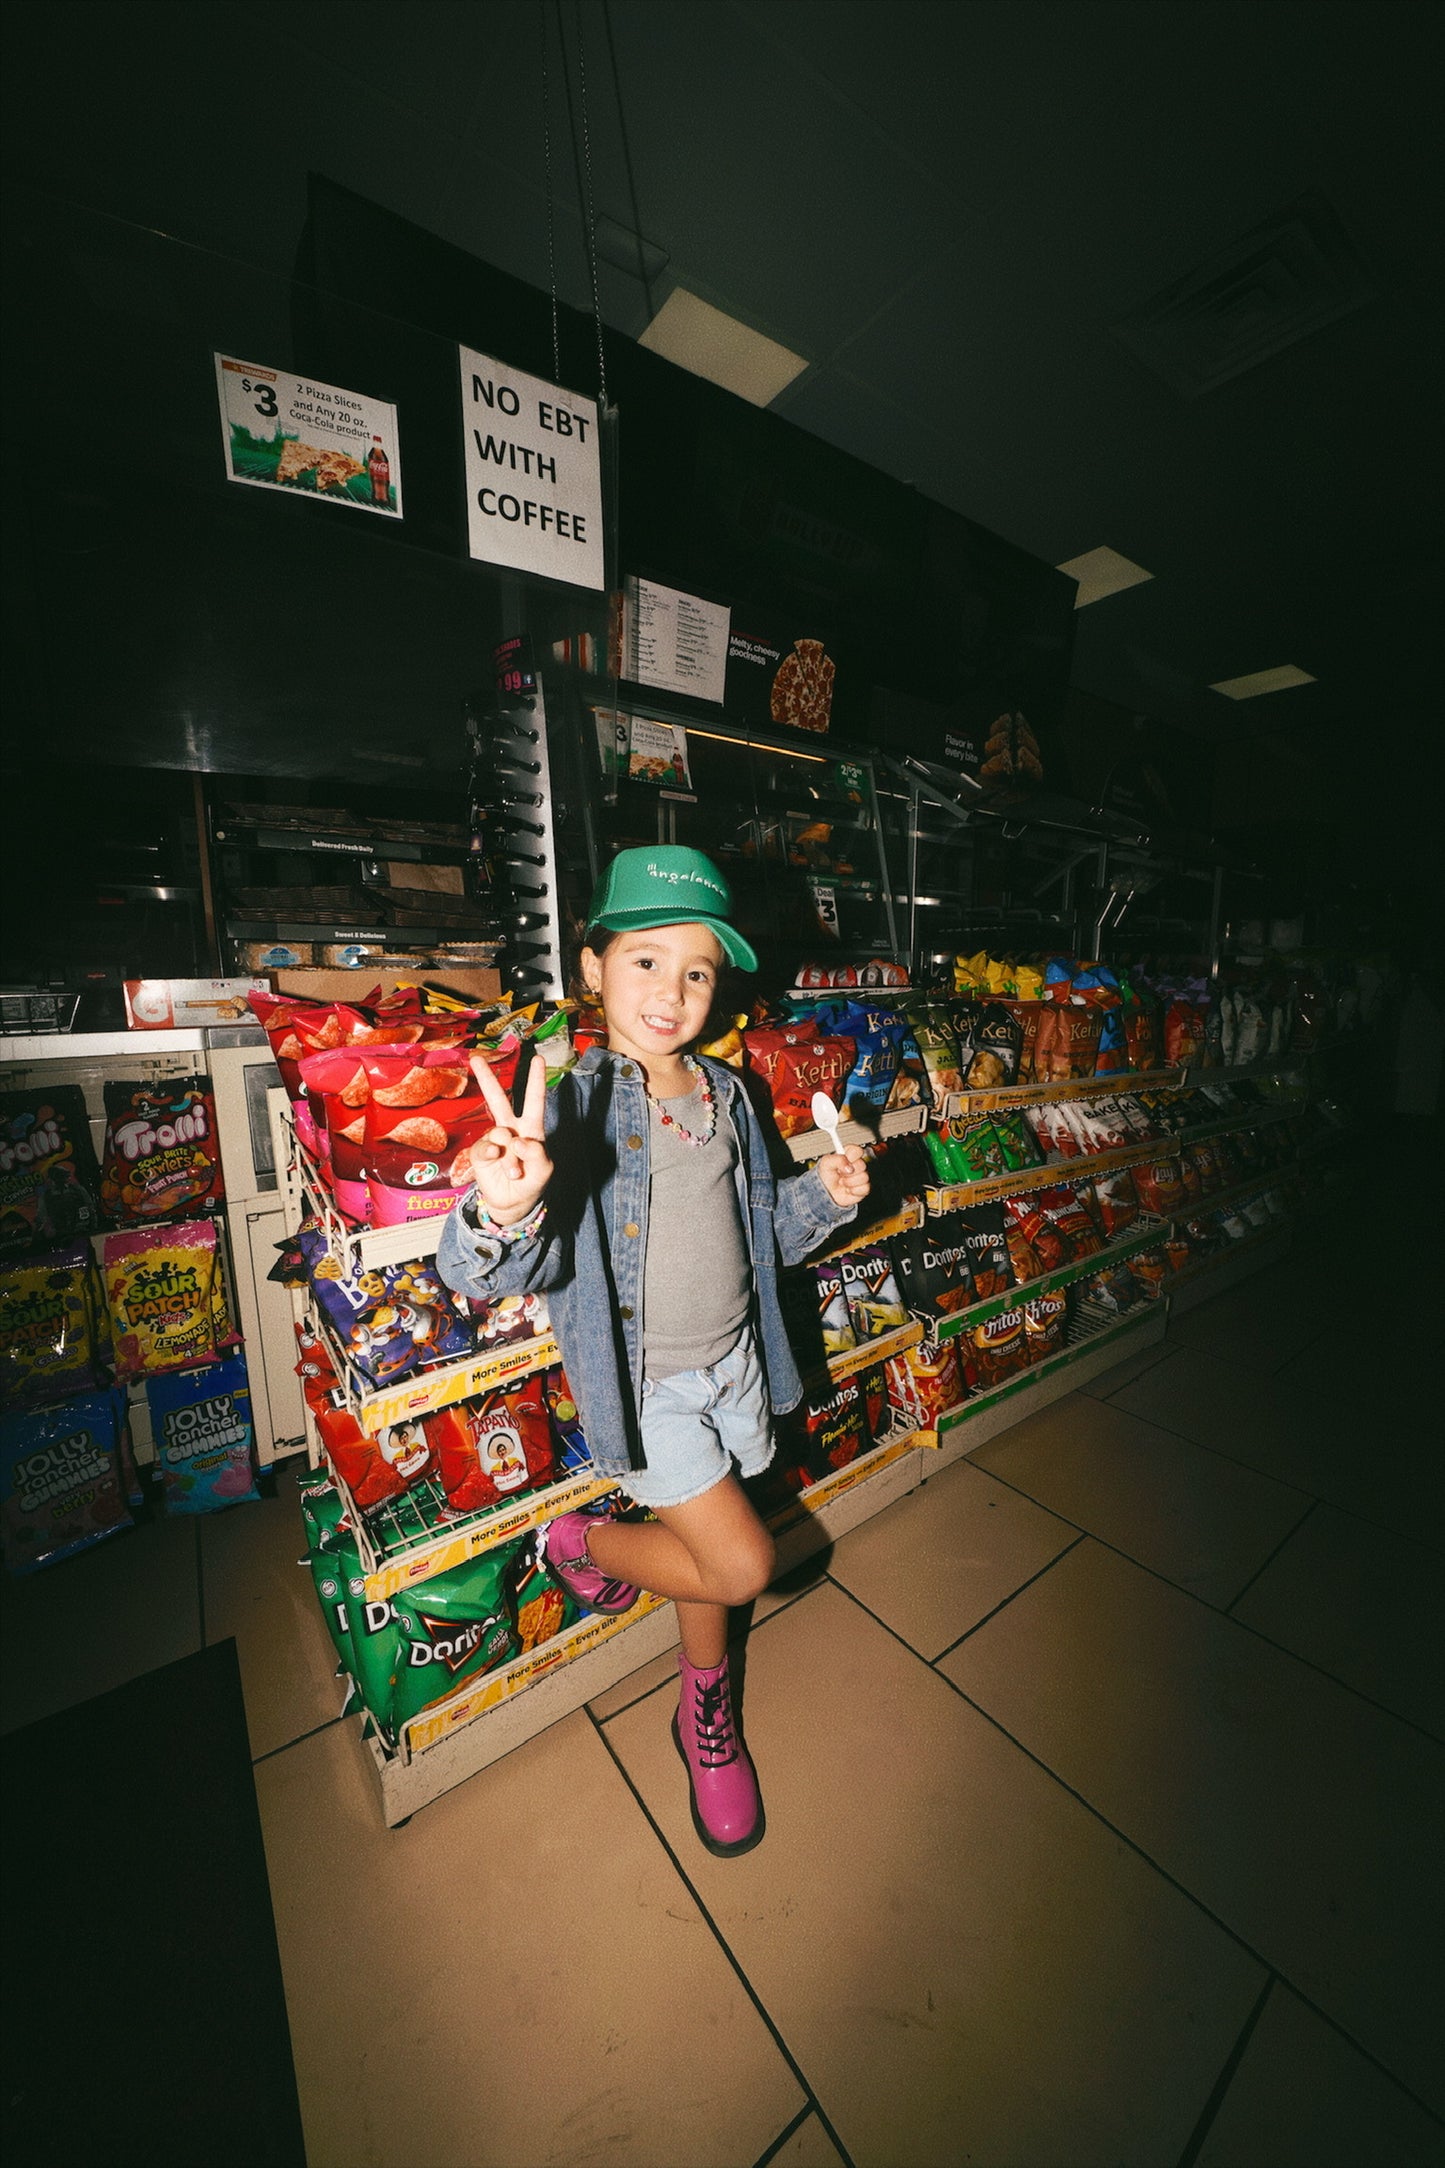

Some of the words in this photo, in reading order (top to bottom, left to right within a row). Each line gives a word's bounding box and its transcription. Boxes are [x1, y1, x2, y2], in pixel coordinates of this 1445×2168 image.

[294, 400, 313, 412] and
[316, 405, 336, 420] Any
[338, 411, 350, 423] 20
[354, 418, 368, 428] oz.
[296, 384, 304, 394] 2
[306, 386, 332, 402] Pizza
[334, 395, 362, 410] Slices
[472, 374, 520, 416] NO
[539, 401, 589, 443] EBT
[290, 409, 334, 429] Coca-Cola
[336, 425, 370, 439] product
[474, 429, 556, 483] WITH
[478, 488, 586, 543] COFFEE
[0, 1120, 61, 1171] rolli
[114, 1104, 208, 1160] Trolli
[128, 1156, 192, 1188] Crawlers
[137, 1154, 162, 1170] SOUR
[163, 1148, 190, 1159] BRITE
[406, 1195, 455, 1210] fiery
[922, 1245, 967, 1270] Doritos
[964, 1232, 1005, 1250] oritos
[841, 1258, 893, 1284] Dorito
[128, 1274, 195, 1303] SOUR
[126, 1290, 200, 1326] PATCH
[155, 1318, 210, 1350] LEMONADE
[472, 1366, 498, 1382] More
[500, 1353, 532, 1370] Smiles
[166, 1396, 231, 1436] JOLLY
[172, 1413, 239, 1446] rancher
[16, 1432, 88, 1486] JOLLY
[166, 1424, 246, 1462] GUMMIES
[20, 1456, 110, 1512] GUMMIES
[23, 1448, 100, 1494] rancher
[471, 1528, 497, 1544] More
[498, 1510, 530, 1531] Smiles
[544, 1492, 571, 1509] Every
[572, 1484, 591, 1496] Bite
[506, 1666, 531, 1684] More
[532, 1648, 562, 1669] Smiles
[575, 1626, 600, 1646] Every
[601, 1615, 618, 1629] Bite
